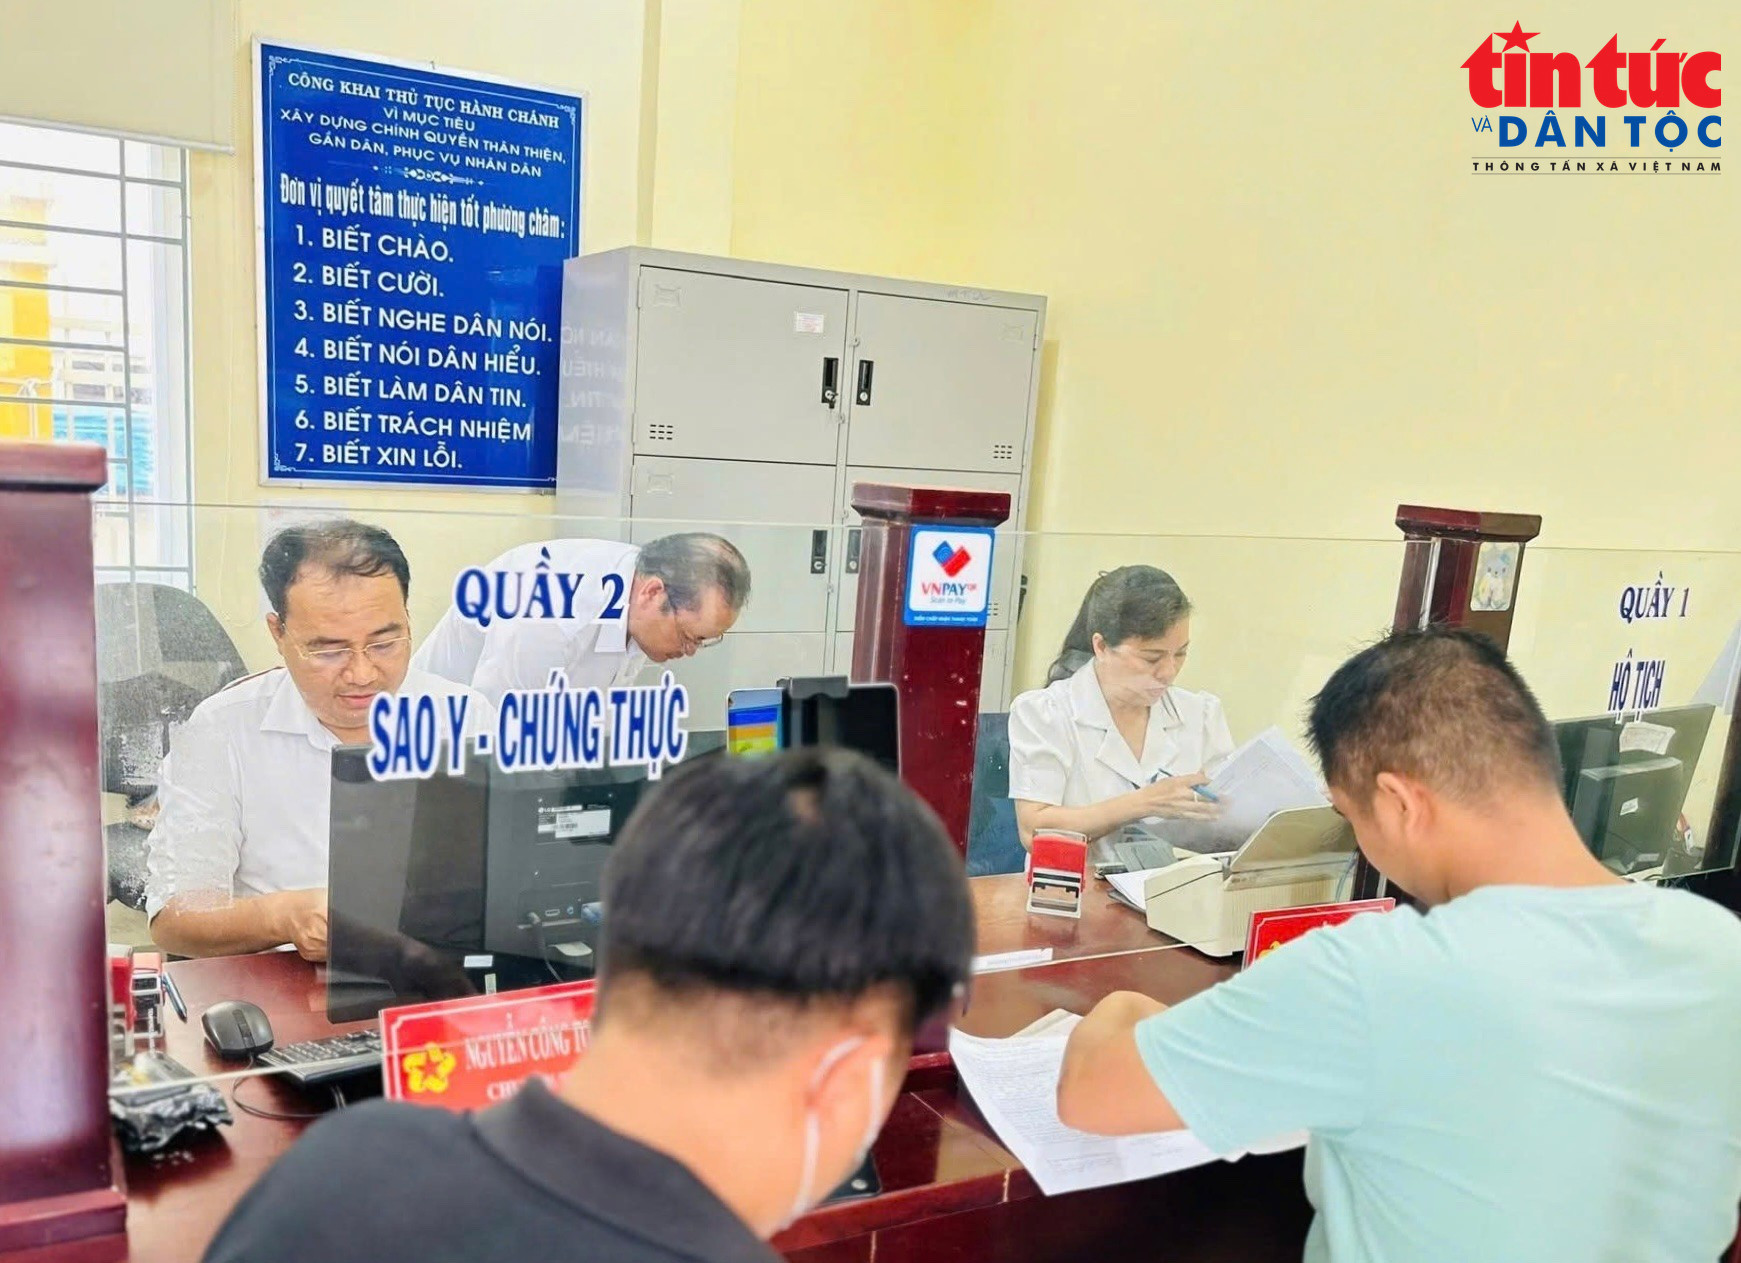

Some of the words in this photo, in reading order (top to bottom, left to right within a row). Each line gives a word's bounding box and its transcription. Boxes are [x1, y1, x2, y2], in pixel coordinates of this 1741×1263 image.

[288, 72, 334, 92] CÔNG
[340, 81, 380, 100] KHAI
[386, 87, 418, 106] THỦ
[424, 94, 455, 113] TỤC
[460, 98, 502, 120] HÀNH
[508, 107, 560, 129] CHÁNH
[384, 107, 399, 119] VÌ
[403, 112, 440, 128] MỤC
[443, 115, 476, 132] TIÊU
[280, 108, 314, 125] XÂY
[320, 114, 367, 132] DỰNG
[372, 121, 420, 141] CHÍNH
[424, 129, 479, 150] QUYỀN
[483, 139, 520, 156] THÂN
[524, 145, 566, 164] THIỆN,
[309, 131, 346, 148] GẦN
[351, 137, 389, 156] DÂN,
[393, 145, 435, 163] PHỤC
[439, 151, 460, 167] VỤ
[465, 156, 507, 173] NHÂN
[511, 160, 542, 178] DÂN
[280, 172, 306, 205] Đơn
[309, 176, 322, 215] vị
[325, 177, 364, 216] quyết
[368, 184, 394, 218] tâm
[398, 188, 426, 227] thực
[430, 193, 457, 232] hiện
[460, 194, 480, 229] tốt
[295, 225, 314, 247] 1.
[322, 224, 371, 253] BIẾT
[378, 234, 454, 263] CHÀO.
[293, 263, 314, 285] 2.
[322, 261, 371, 289] BIẾT
[378, 271, 445, 297] CƯỜI.
[294, 300, 314, 322] 3.
[323, 298, 371, 326] BIẾT
[378, 309, 447, 333] NGHE
[453, 314, 502, 338] DÂN
[510, 320, 553, 342] NÓI.
[294, 338, 315, 359] 4.
[323, 335, 372, 362] BIẾT
[379, 341, 420, 366] NÓI
[427, 347, 477, 371] DÂN
[484, 345, 541, 376] HIỂU.
[295, 375, 315, 395] 5.
[323, 371, 372, 399] BIẾT
[379, 375, 428, 402] LÀM
[435, 382, 483, 405] DÂN
[490, 387, 527, 408] TIN.
[295, 410, 315, 431] 6.
[323, 407, 372, 433] BIẾT
[378, 410, 452, 436] TRÁCH
[460, 417, 532, 442] NHIỆM
[295, 444, 314, 463] 7.
[323, 440, 371, 465] BIẾT
[377, 446, 416, 467] XIN
[423, 440, 463, 469] LỖI.
[456, 546, 584, 627] QUẦY
[600, 573, 625, 619] 2
[1620, 570, 1674, 624] QUẦY
[1679, 587, 1689, 617] 1
[1608, 648, 1633, 722] HỘ
[1632, 660, 1665, 722] TỊCH
[371, 694, 436, 775] SAO
[447, 695, 468, 770] Y
[478, 734, 488, 749] -
[500, 670, 602, 768] CHỨNG
[611, 673, 685, 775] THỰC
[466, 1012, 529, 1071] NGUYỄN
[529, 1016, 569, 1062] CÔNG
